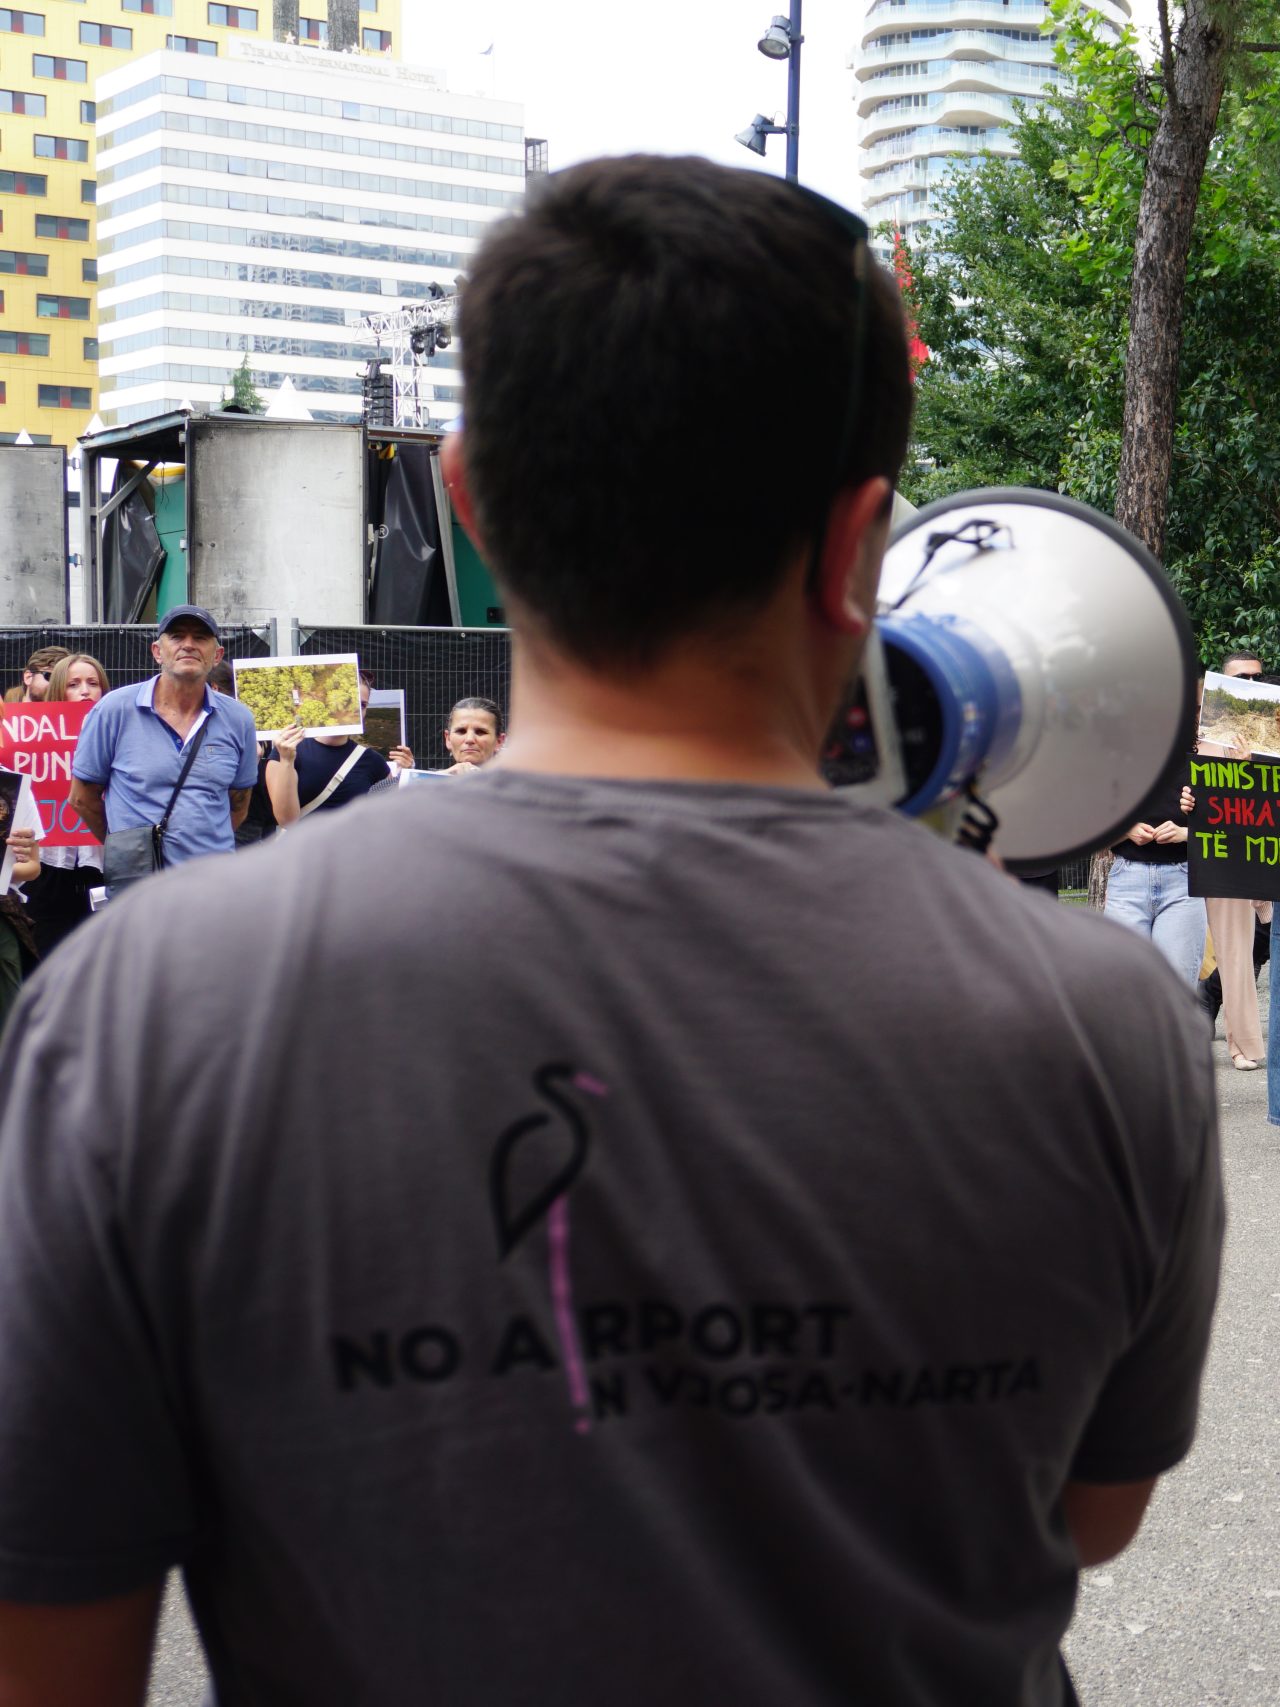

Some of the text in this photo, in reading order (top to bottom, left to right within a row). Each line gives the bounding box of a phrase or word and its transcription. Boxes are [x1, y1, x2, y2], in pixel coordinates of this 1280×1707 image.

[396, 66, 437, 84] HOTEL
[2, 713, 88, 742] NDAL
[14, 750, 77, 782] PUN
[1195, 830, 1228, 859] TË
[334, 1323, 461, 1391] NO
